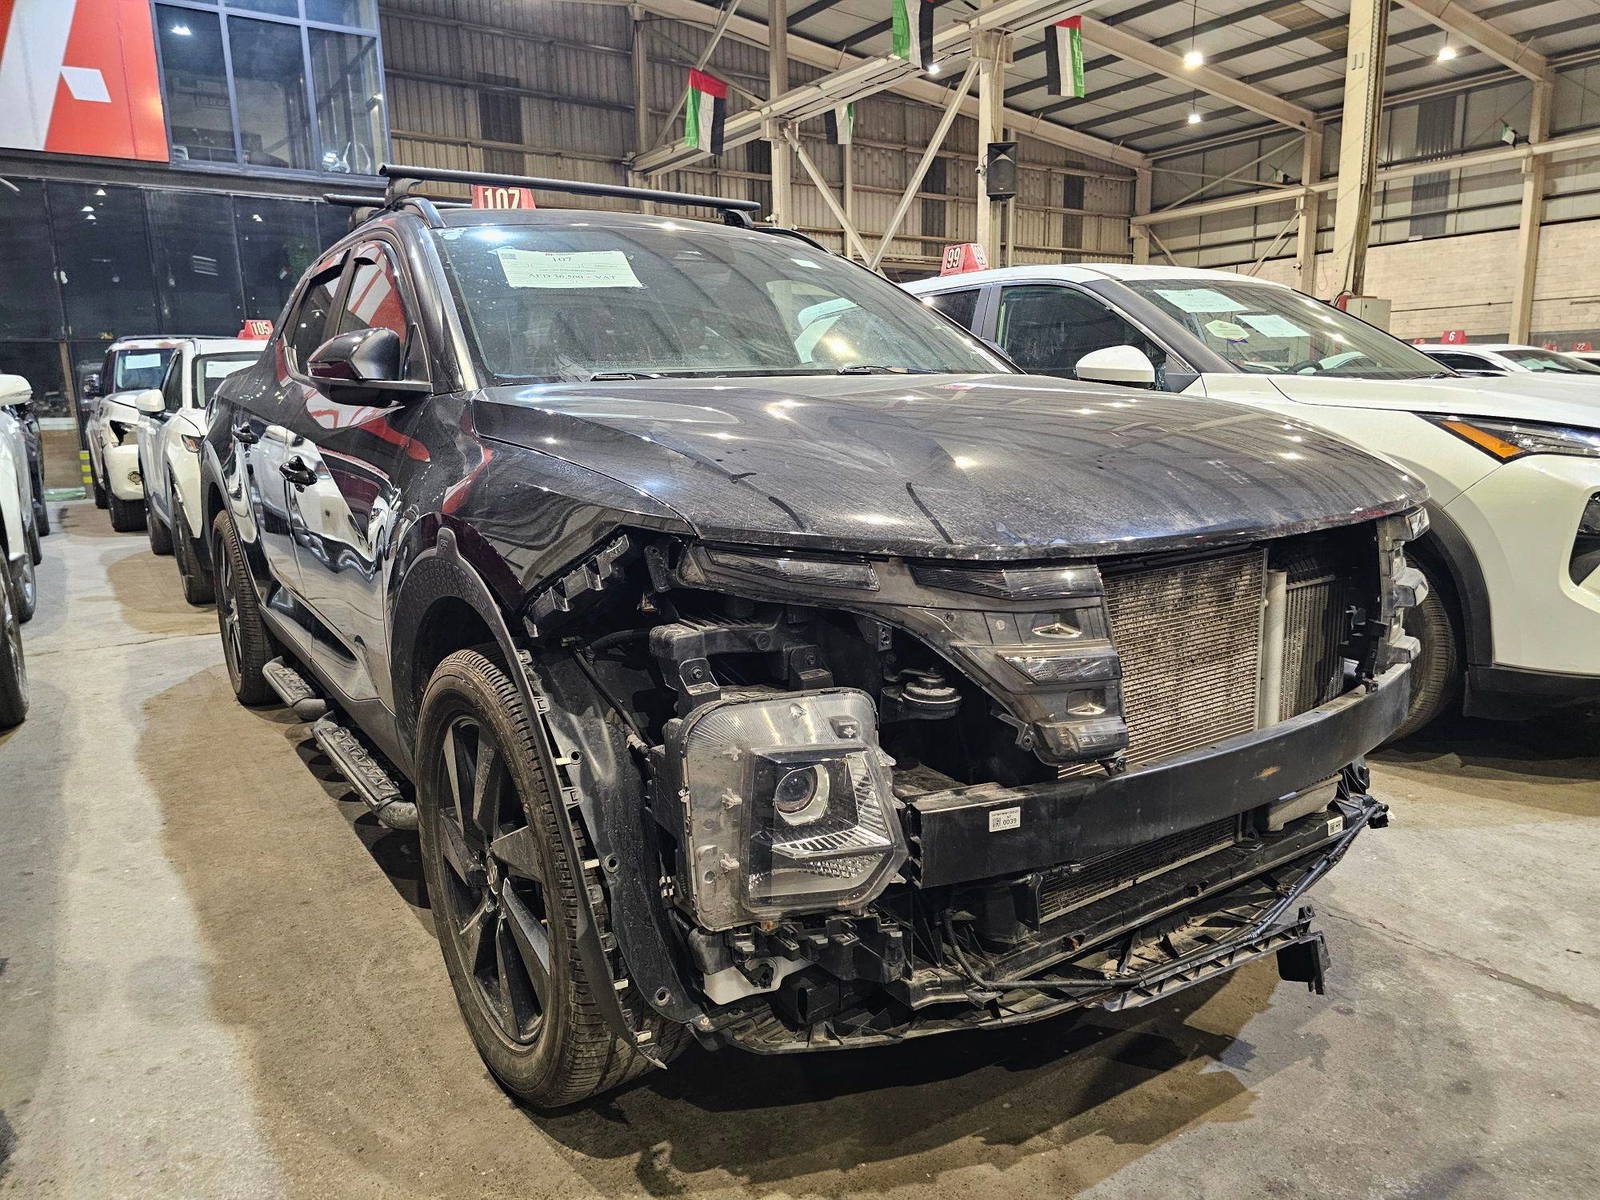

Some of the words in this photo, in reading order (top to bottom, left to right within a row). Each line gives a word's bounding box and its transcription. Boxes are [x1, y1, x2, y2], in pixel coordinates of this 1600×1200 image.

[484, 188, 520, 209] 107
[946, 247, 961, 269] 99
[252, 321, 269, 336] 105
[1448, 331, 1457, 342] 6
